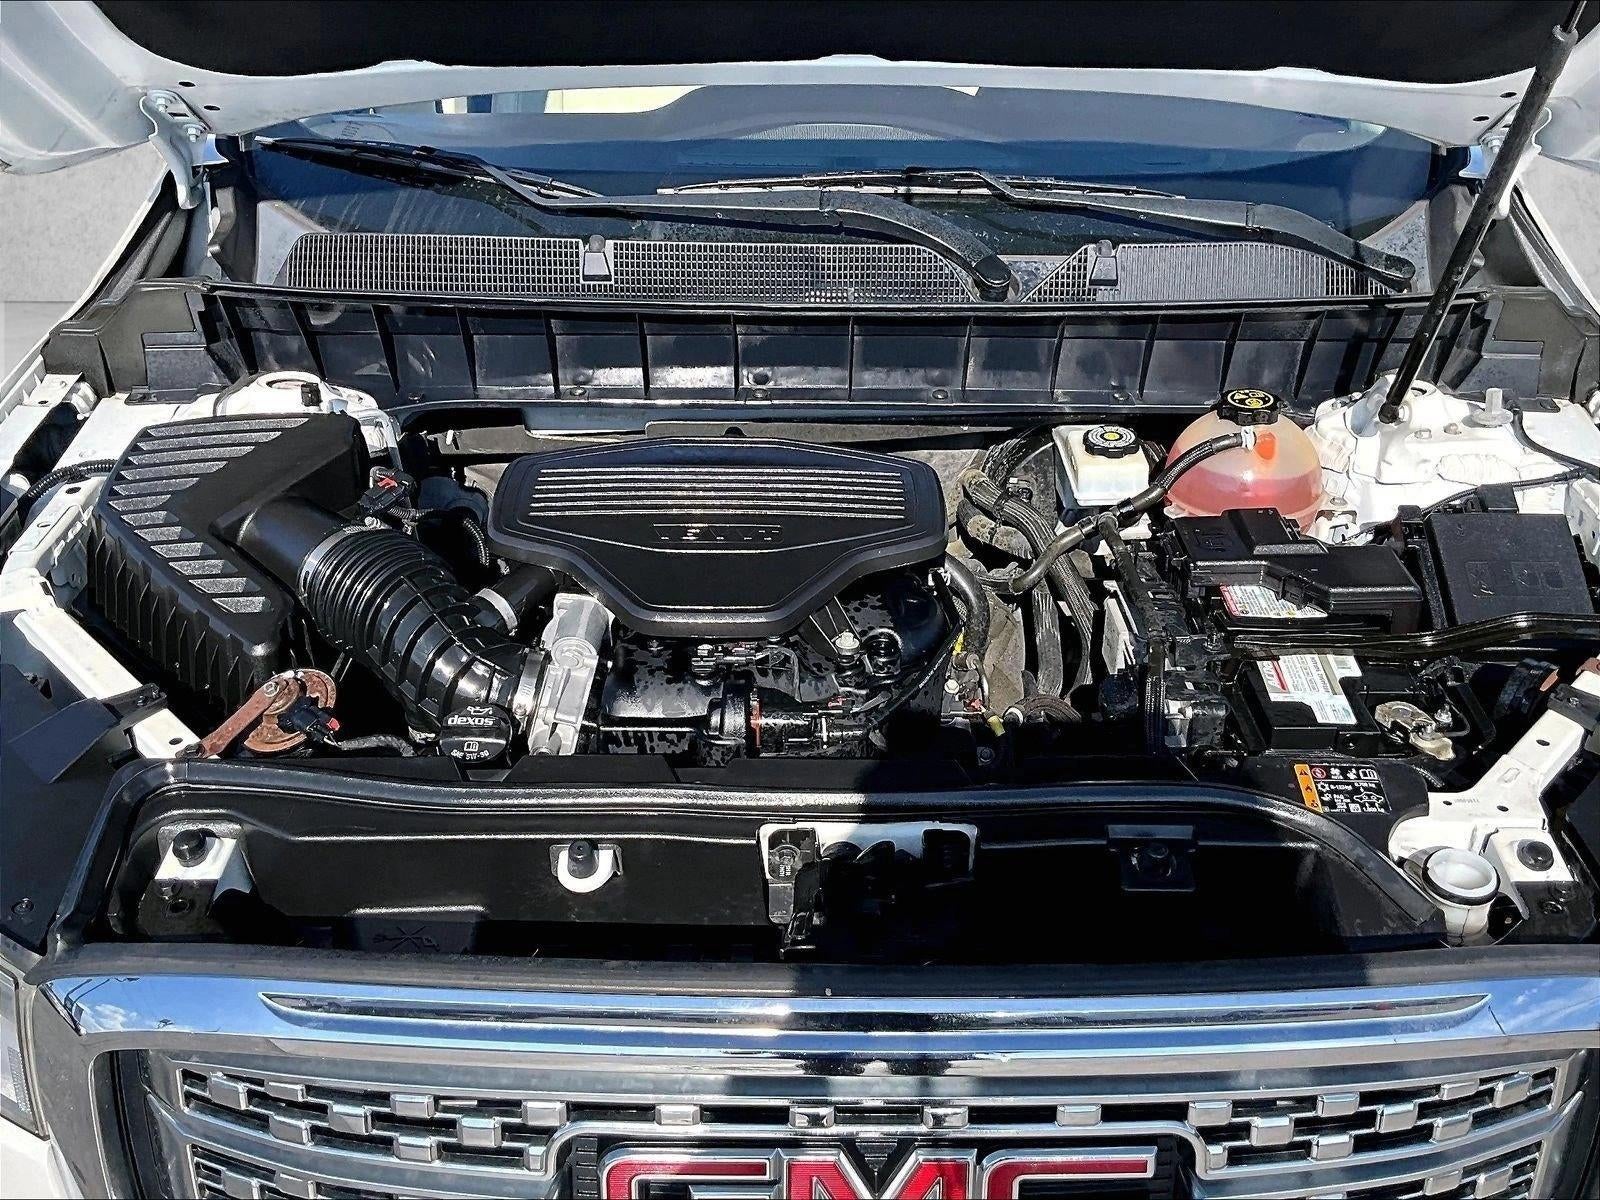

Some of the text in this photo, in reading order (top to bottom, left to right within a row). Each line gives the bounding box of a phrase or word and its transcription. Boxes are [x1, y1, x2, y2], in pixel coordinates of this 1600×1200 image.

[448, 715, 495, 726] dexos
[451, 749, 489, 760] SAE 5W-30
